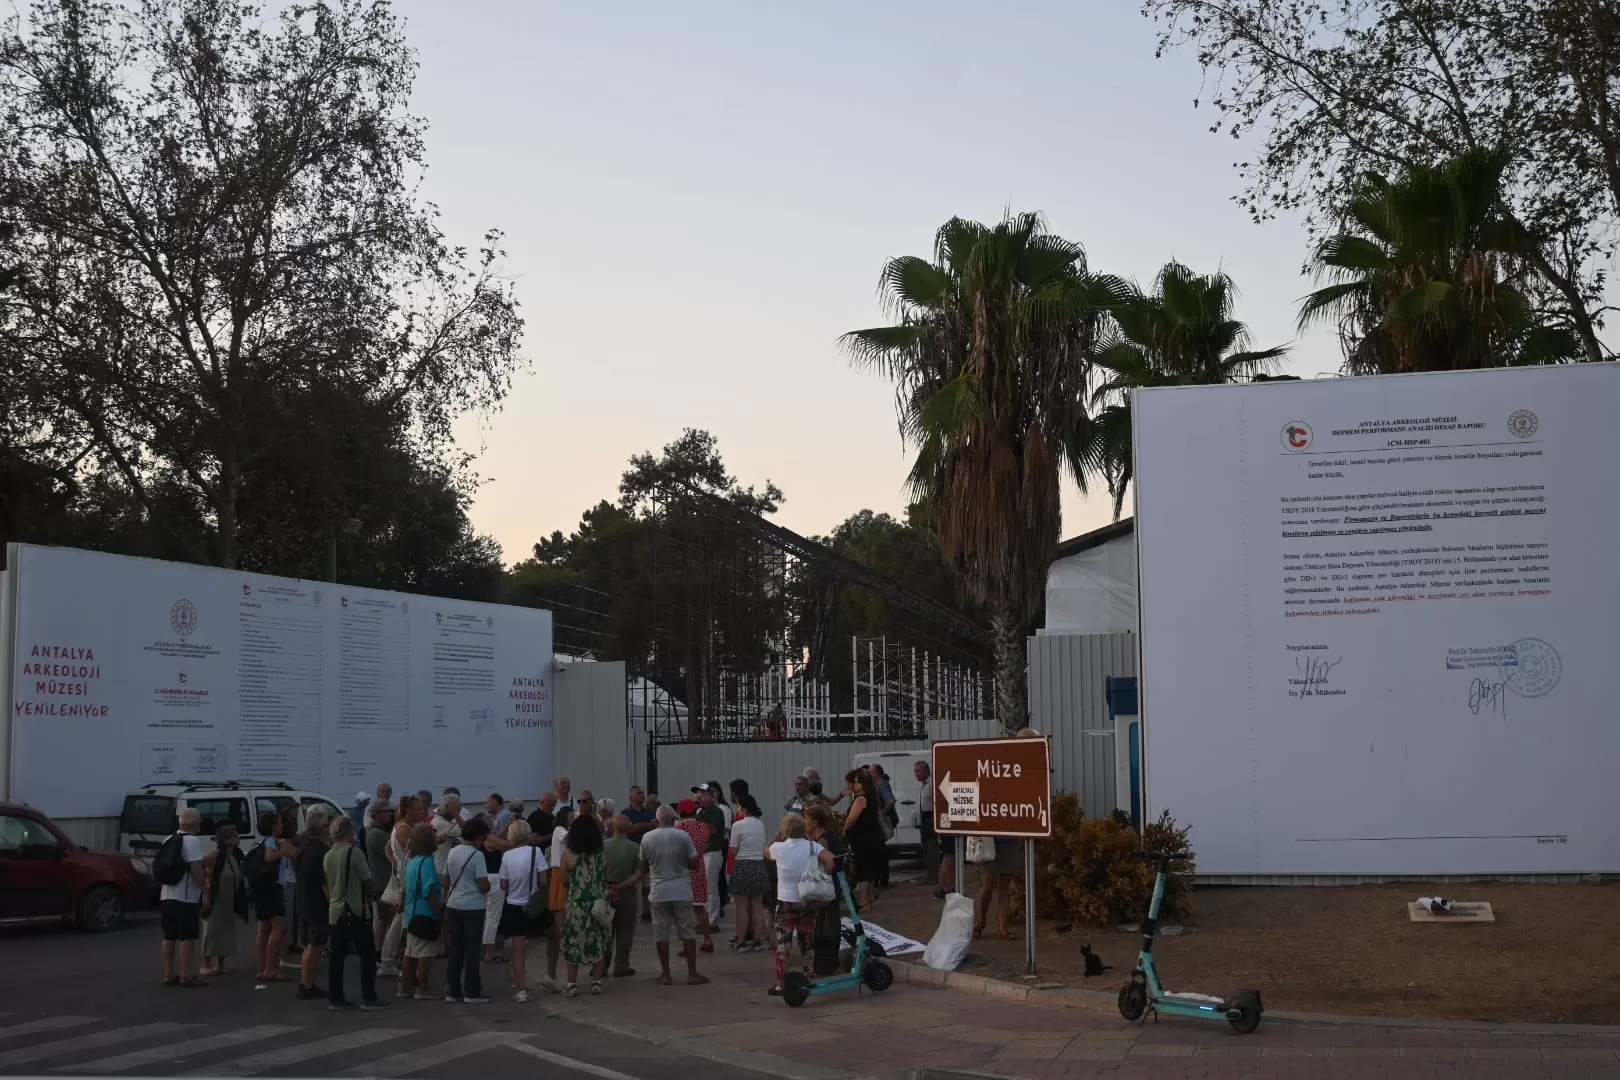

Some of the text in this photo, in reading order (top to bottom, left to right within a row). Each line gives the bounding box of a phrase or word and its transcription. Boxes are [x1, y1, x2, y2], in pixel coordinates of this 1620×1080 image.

[32, 644, 94, 660] ANTALYA
[24, 663, 100, 678] ARKEOLOJİ
[36, 680, 87, 696] MÜZESİ
[513, 677, 544, 687] ANTALYA
[509, 690, 548, 700] ARKEOLOJİ
[516, 702, 542, 712] MÜZESİ
[978, 759, 1021, 778] Müze
[981, 795, 1042, 820] useum)
